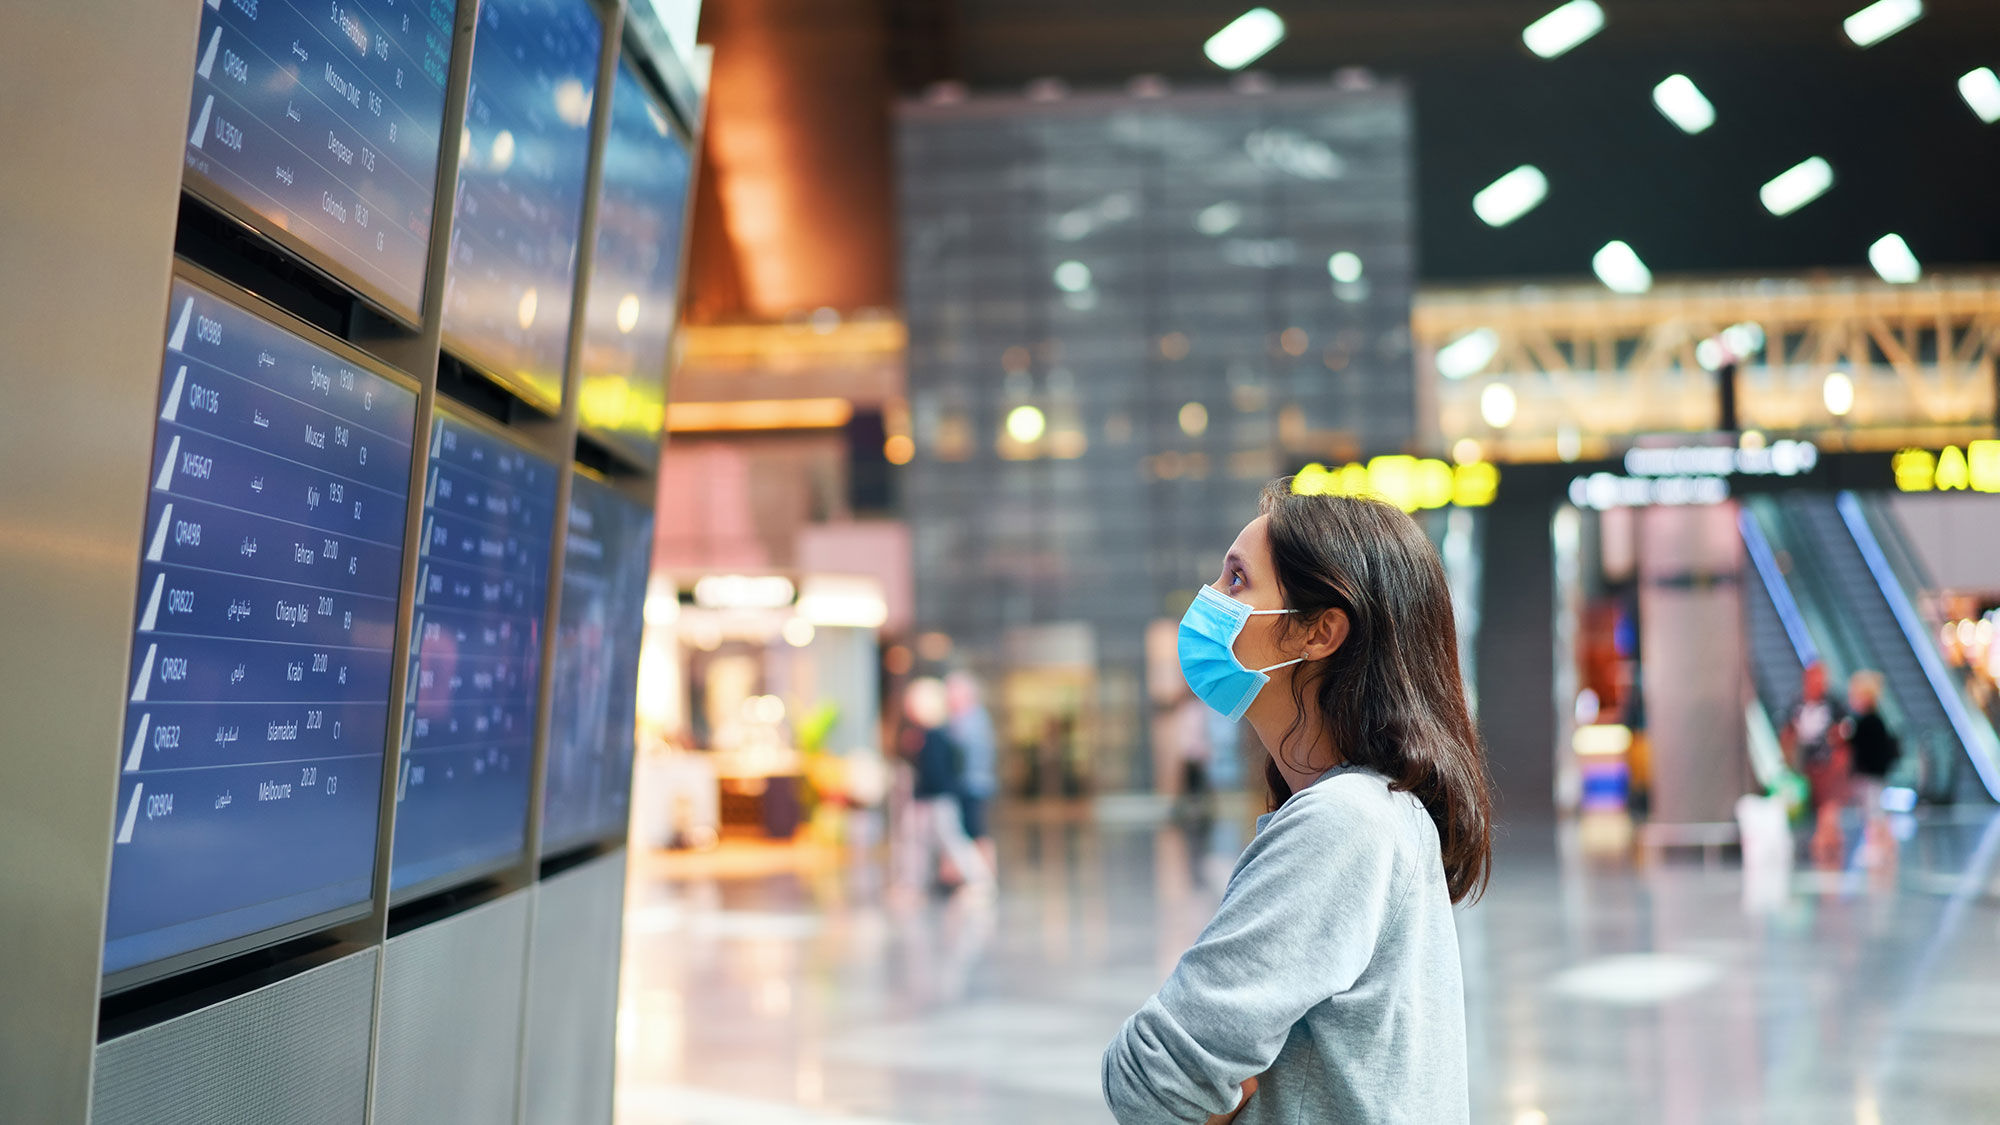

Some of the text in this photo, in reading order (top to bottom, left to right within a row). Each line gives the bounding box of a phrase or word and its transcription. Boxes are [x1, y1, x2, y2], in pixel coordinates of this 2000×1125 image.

[339, 9, 368, 57] Petersburg
[376, 34, 389, 61] 16:05
[225, 50, 248, 85] QR964
[324, 62, 361, 109] Moscow DME
[369, 91, 382, 117] 16:55
[217, 118, 243, 151] UL3504
[389, 123, 397, 143] B3
[328, 131, 354, 165] Denpasar
[362, 147, 375, 172] 17:25
[323, 192, 346, 223] Colombo
[355, 204, 369, 228] 18:30
[198, 315, 222, 345] QR988
[311, 366, 331, 395] Sydney
[340, 370, 354, 391] 19:00
[191, 384, 219, 414] QR1136
[364, 392, 372, 411] C5
[254, 410, 269, 428] مسقط
[305, 425, 325, 449] Muscat
[335, 426, 349, 447] 19:40
[183, 453, 212, 479] XH5647
[360, 447, 367, 466] C9
[307, 487, 320, 511] Kyiv
[330, 483, 343, 503] 19:50
[176, 521, 201, 546] QR498
[295, 543, 314, 564] Tehran
[323, 539, 338, 559] 20:00
[349, 557, 357, 575] A5
[169, 589, 194, 613] QR822
[318, 596, 333, 616] 20:00
[275, 601, 309, 627] Chiang Mai
[162, 658, 187, 682] QR824
[287, 662, 303, 682] Krabi
[312, 654, 328, 672] 20:00
[338, 667, 347, 684] A6
[268, 720, 298, 741] Islamabad
[307, 711, 322, 729] 20:20
[334, 721, 341, 739] C1
[155, 726, 180, 751] QR632
[301, 768, 317, 786] 20:20
[327, 776, 337, 795] C13
[259, 781, 291, 801] Melbourne
[148, 794, 173, 820] QR904
